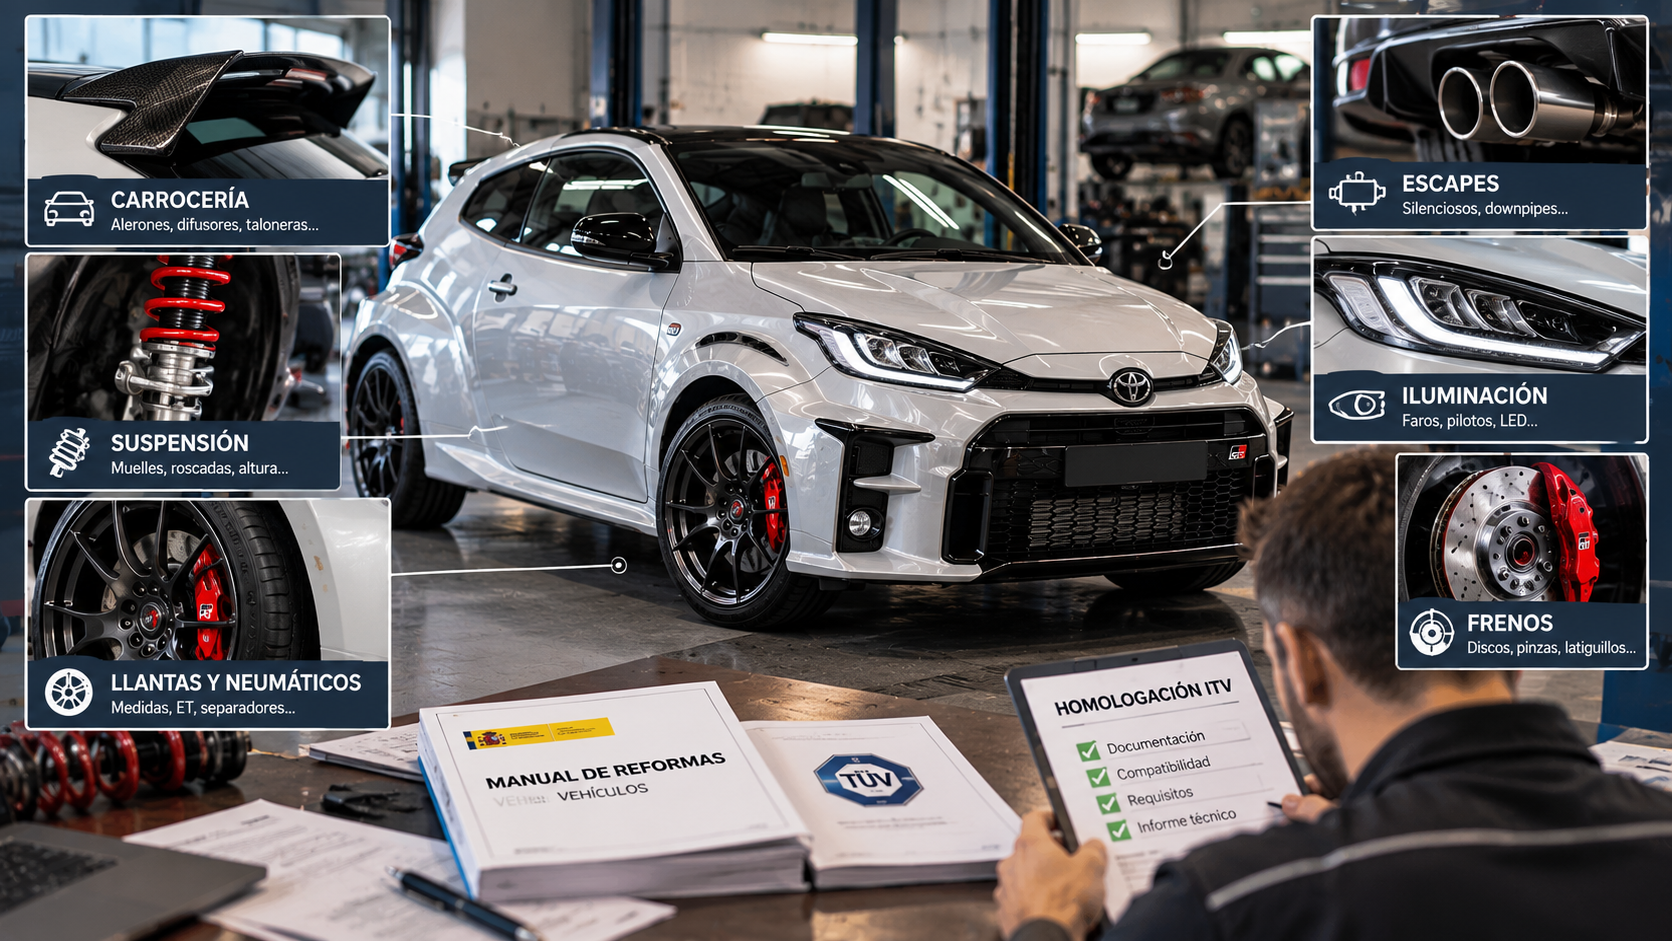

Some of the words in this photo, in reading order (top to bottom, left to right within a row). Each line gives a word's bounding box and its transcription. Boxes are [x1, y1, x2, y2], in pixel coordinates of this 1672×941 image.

[1054, 681, 1202, 716] HOMOLOGACIÓN
[1204, 678, 1232, 695] ITV
[1107, 730, 1206, 754] Documentación
[485, 770, 579, 789] MANUAL
[581, 766, 611, 780] DE
[613, 752, 726, 777] REFORMAS
[839, 769, 893, 789] TÜV
[1117, 755, 1211, 780] Compatibilidad
[557, 783, 649, 801] VEHÍCULOS
[1127, 787, 1194, 806] Requisitos
[1137, 815, 1187, 834] Informe
[1189, 808, 1237, 824] técnico
